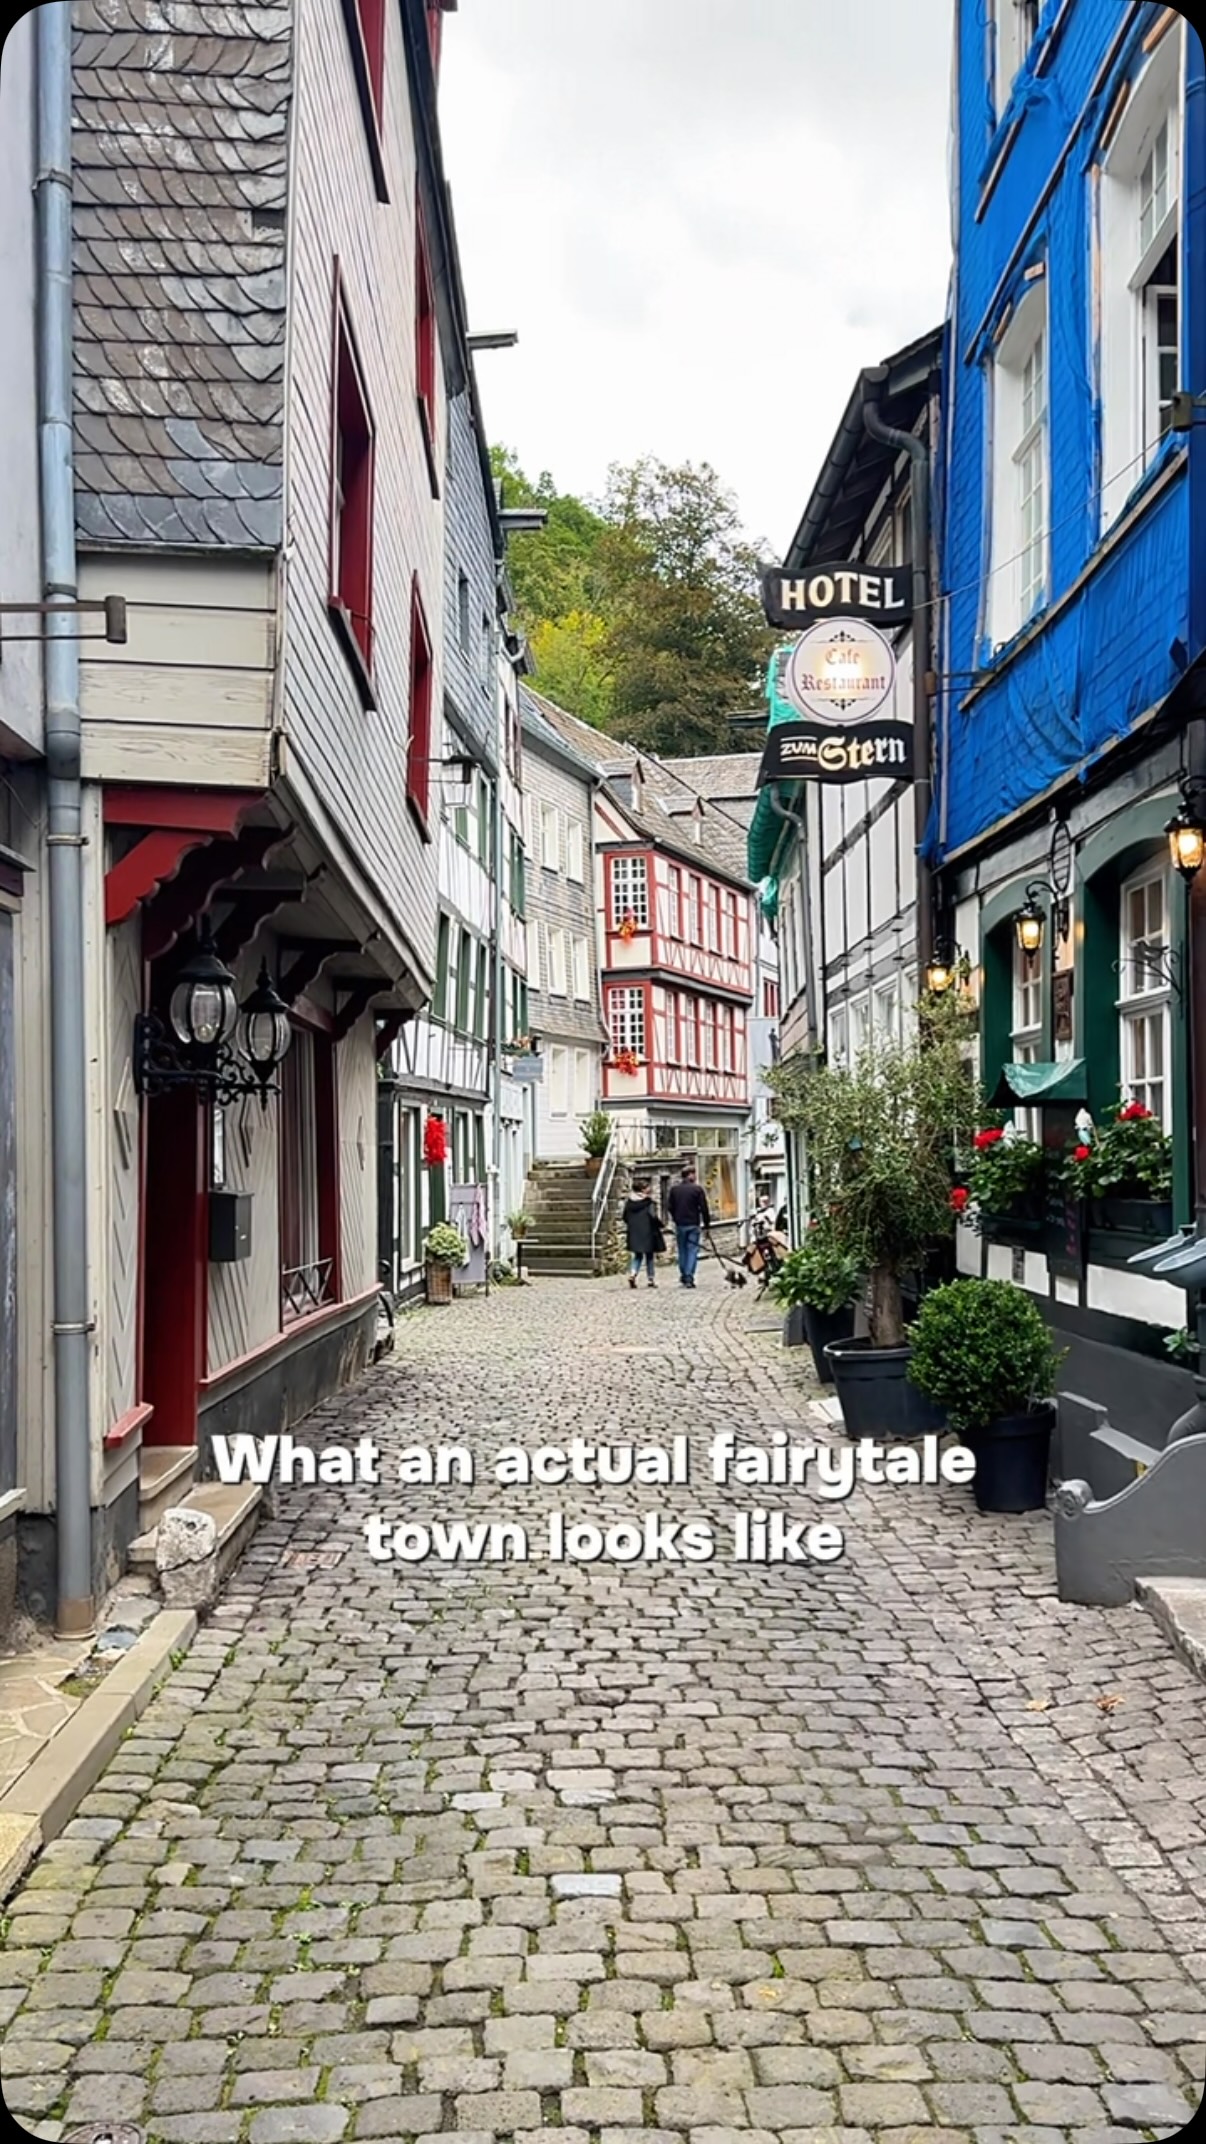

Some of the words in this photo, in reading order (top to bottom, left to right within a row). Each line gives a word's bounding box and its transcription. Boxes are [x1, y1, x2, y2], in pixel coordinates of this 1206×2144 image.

[780, 571, 905, 611] HOTEL
[801, 674, 886, 691] Restaurant
[818, 736, 906, 771] Stern
